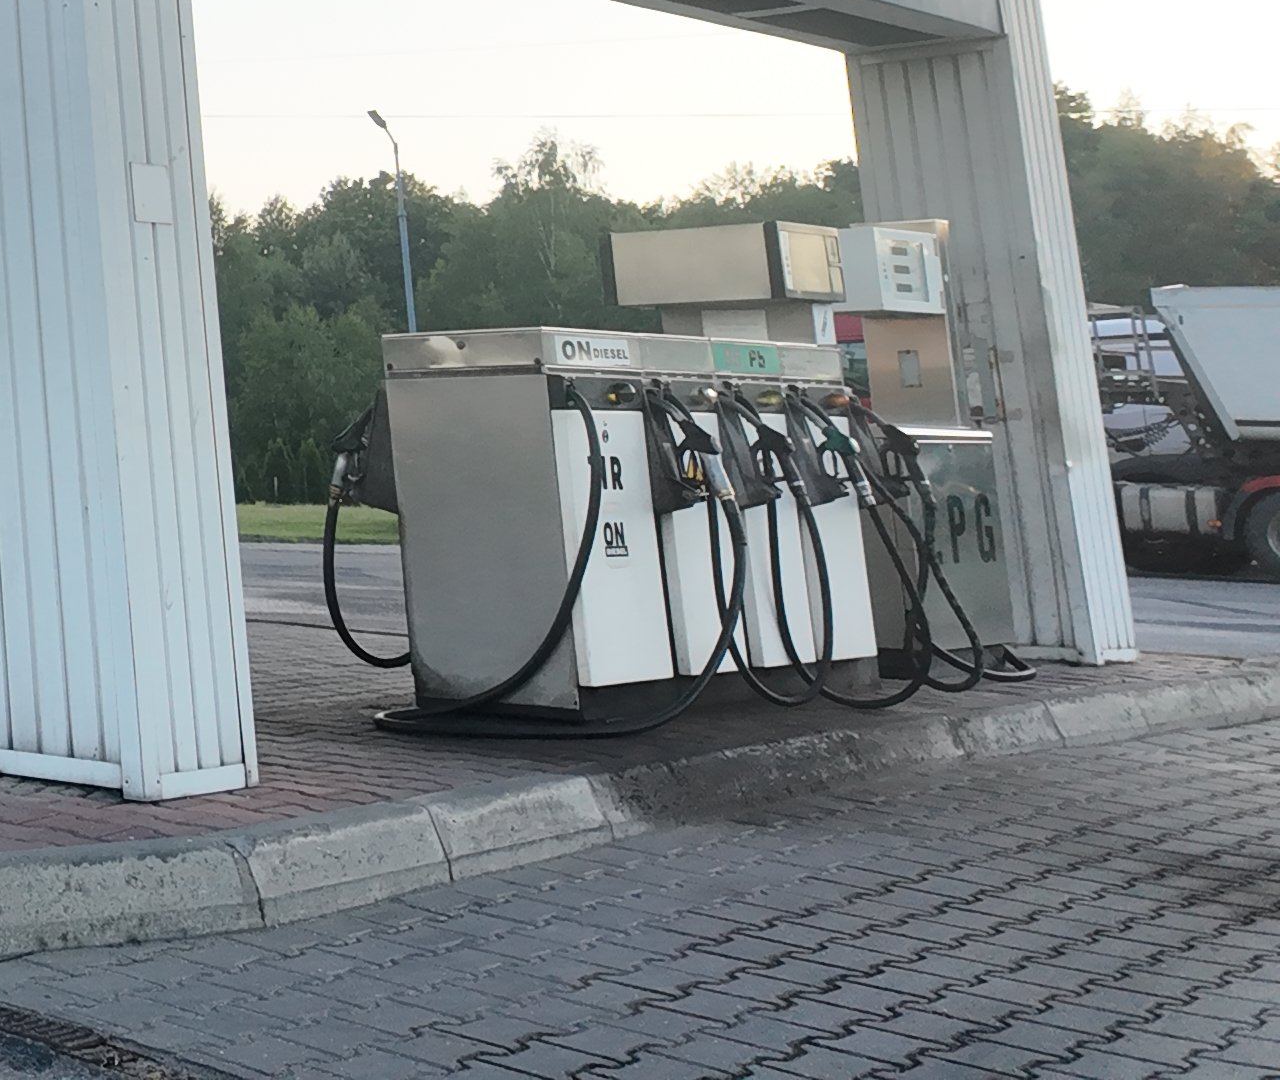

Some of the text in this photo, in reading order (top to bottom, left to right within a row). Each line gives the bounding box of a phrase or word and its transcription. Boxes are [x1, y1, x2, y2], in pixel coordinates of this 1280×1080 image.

[561, 339, 629, 362] ON DIESEL
[603, 522, 626, 546] ON
[937, 493, 997, 565] PG
